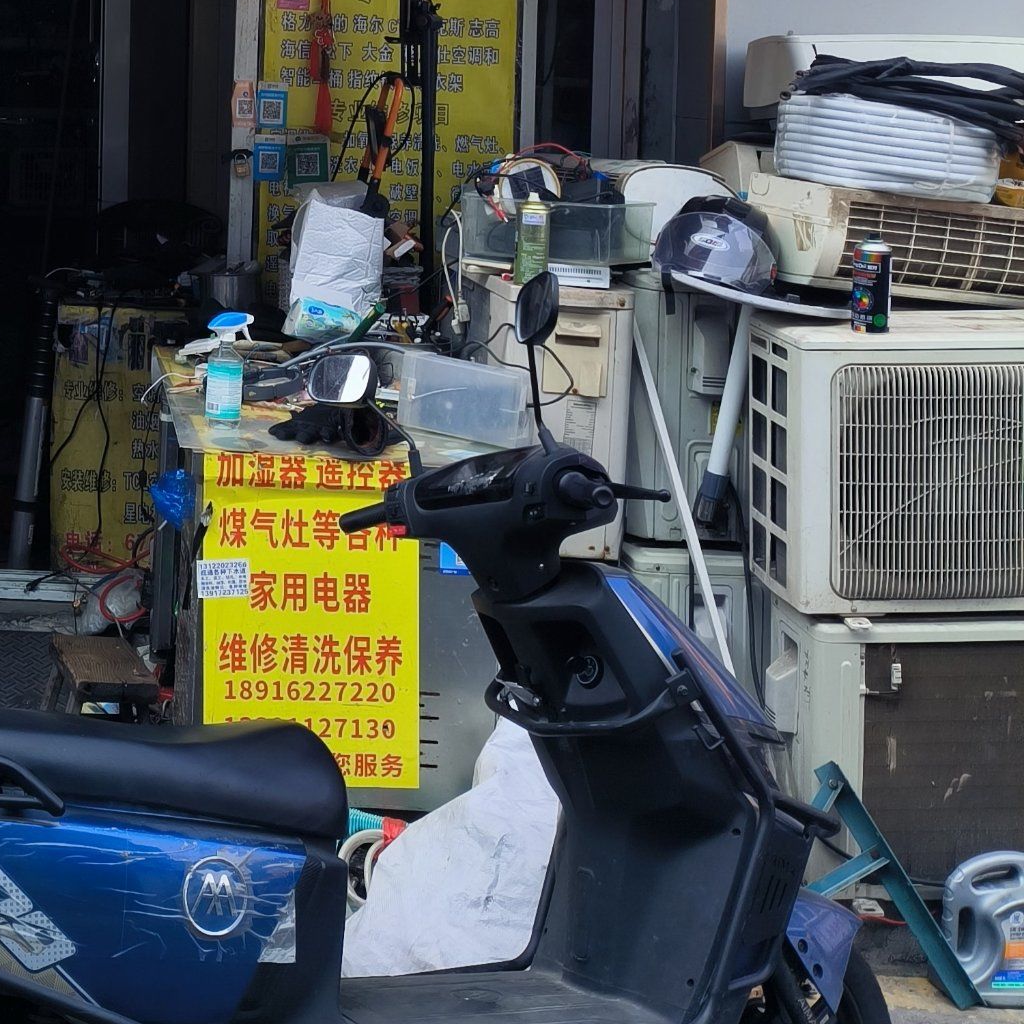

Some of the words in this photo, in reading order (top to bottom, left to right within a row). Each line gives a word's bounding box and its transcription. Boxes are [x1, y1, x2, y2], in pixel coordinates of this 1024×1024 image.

[353, 14, 384, 35] 海尔
[468, 18, 500, 39] 志高
[362, 42, 394, 62] 大金
[216, 453, 308, 490] 加湿器
[250, 571, 372, 614] 家用电器
[218, 632, 403, 677] 维修清洗保养
[224, 680, 396, 703] 18916227220
